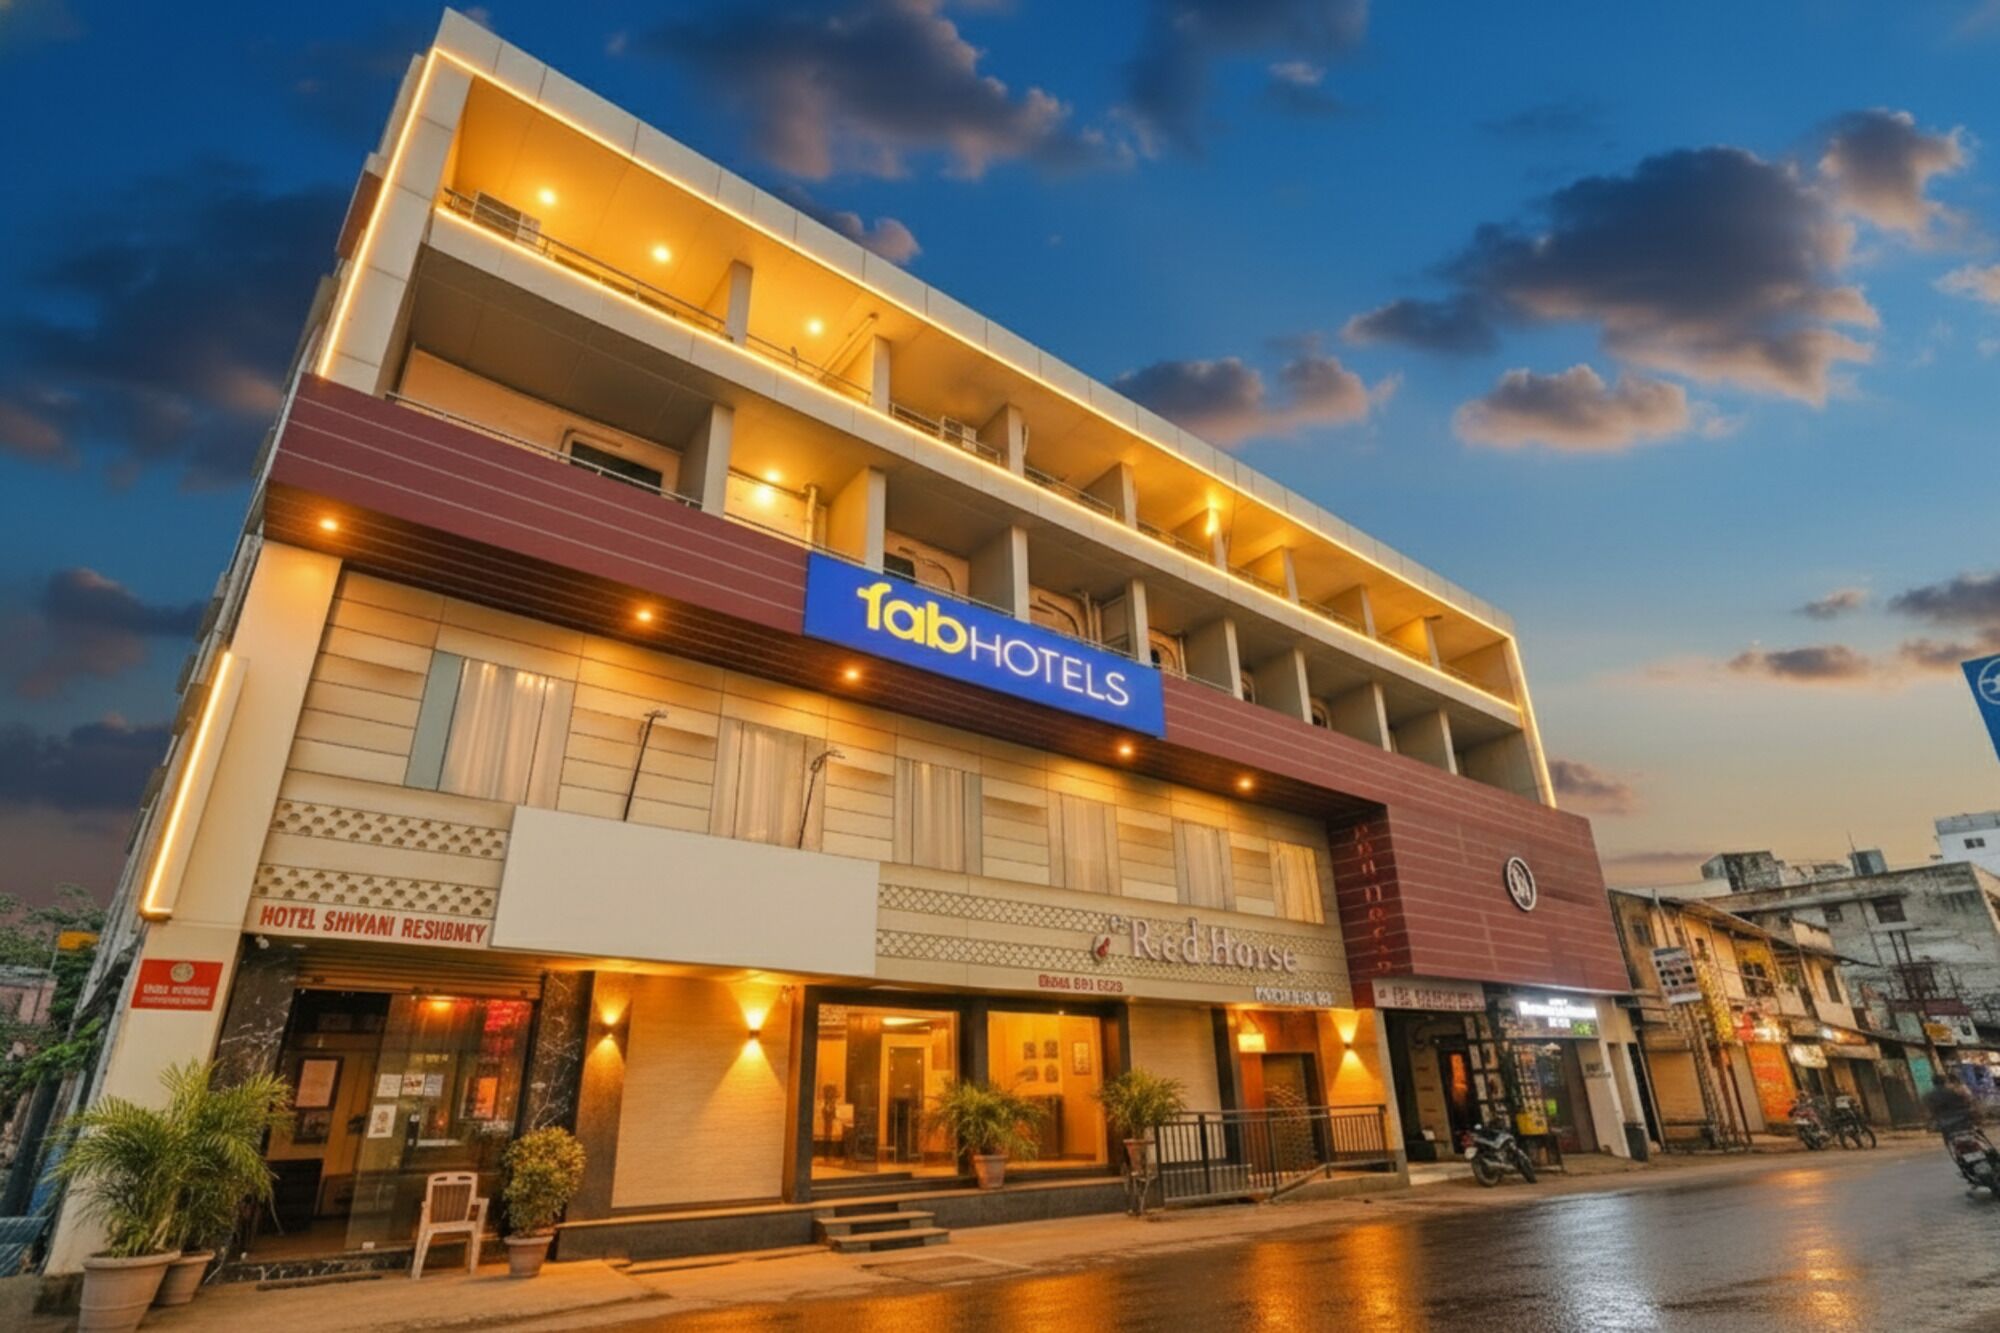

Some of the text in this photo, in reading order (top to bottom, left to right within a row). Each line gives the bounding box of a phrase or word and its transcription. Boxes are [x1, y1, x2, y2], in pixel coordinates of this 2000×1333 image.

[259, 905, 316, 930] HOTEL
[323, 910, 396, 937] SHIVANI
[1131, 917, 1200, 966] Red
